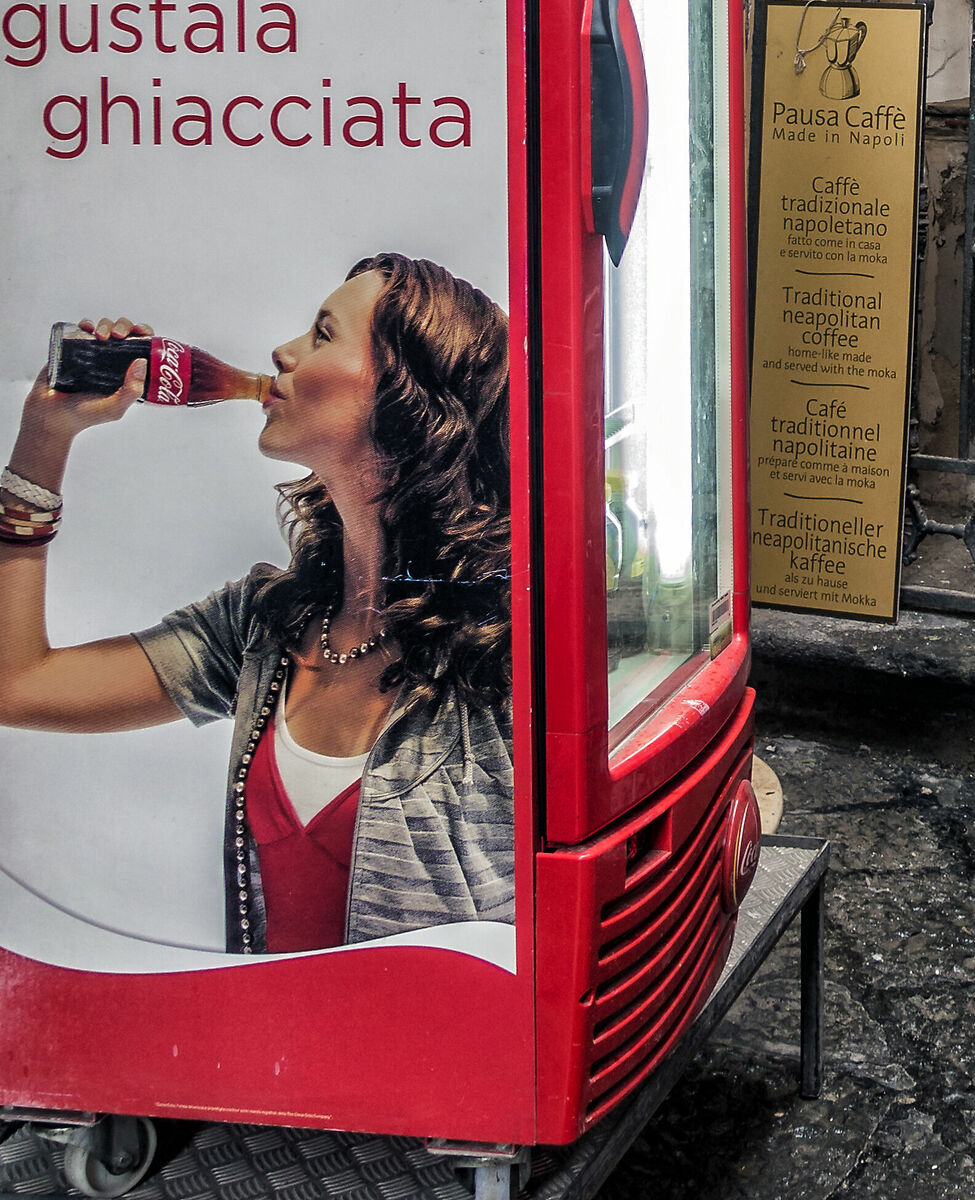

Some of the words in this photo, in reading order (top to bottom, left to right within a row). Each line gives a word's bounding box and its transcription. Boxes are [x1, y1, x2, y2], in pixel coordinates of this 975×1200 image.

[43, 78, 472, 159] ghiacciata
[772, 102, 839, 127] Pausa
[845, 105, 906, 130] Caffè
[772, 127, 816, 142] Made
[825, 129, 840, 143] in
[850, 131, 905, 149] Napoli
[812, 176, 860, 196] Caffè
[781, 196, 890, 217] tradizionale
[782, 215, 888, 237] napoletano
[788, 234, 813, 246] fatto
[814, 239, 844, 248] come
[846, 237, 856, 249] in
[858, 240, 881, 250] casa
[780, 248, 786, 258] e
[788, 248, 823, 261] servito
[824, 252, 844, 262] con
[846, 250, 856, 263] la
[858, 251, 888, 265] moka
[782, 286, 882, 311] Traditional
[782, 307, 880, 331] neapolitan
[802, 327, 858, 349] coffee
[788, 345, 840, 362] home-like
[842, 349, 872, 364] made
[762, 358, 782, 370] and
[784, 360, 818, 374] served
[820, 361, 845, 375] with
[847, 363, 864, 377] the
[867, 366, 897, 380] moka
[806, 398, 847, 419] Café
[770, 416, 880, 442] traditionnel
[772, 437, 877, 463] napolitaine
[757, 454, 798, 469] préparé
[800, 460, 840, 473] comme
[851, 463, 890, 477] maison
[770, 470, 780, 480] et
[782, 471, 807, 484] servi
[808, 474, 833, 486] avec
[834, 473, 844, 487] la
[846, 475, 876, 490] moka
[758, 508, 884, 538] Traditioneller
[752, 530, 888, 560] neapolitanische
[789, 552, 846, 575] kaffee
[784, 572, 799, 584] als
[801, 575, 815, 585] zu
[816, 574, 848, 590] hause
[756, 582, 776, 595] und
[778, 586, 818, 601] serviert
[820, 590, 839, 603] mit
[841, 592, 877, 607] Mokka
